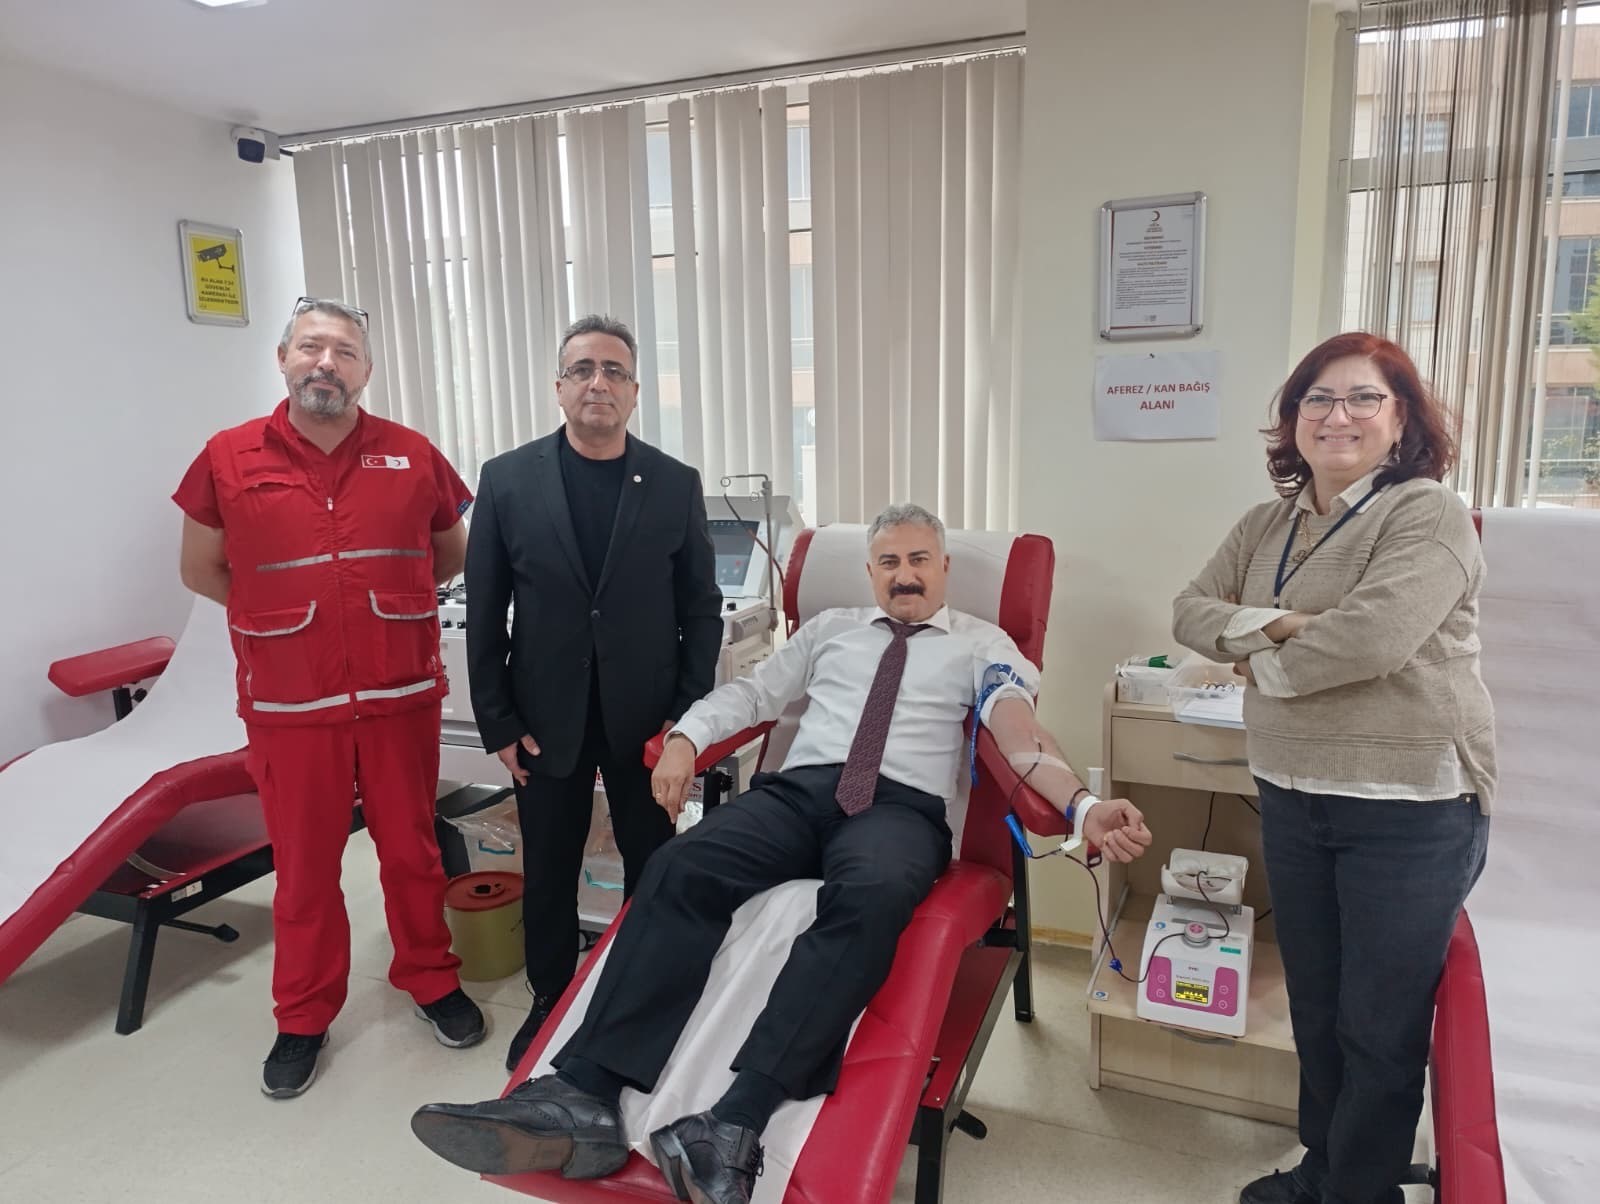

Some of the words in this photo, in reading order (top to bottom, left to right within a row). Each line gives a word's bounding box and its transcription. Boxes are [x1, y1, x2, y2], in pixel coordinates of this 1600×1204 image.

[1107, 385, 1144, 395] AFEREZ
[1146, 384, 1152, 395] /
[1154, 383, 1176, 393] KAN
[1179, 381, 1210, 393] BAĞIŞ
[1140, 400, 1175, 410] ALANI
